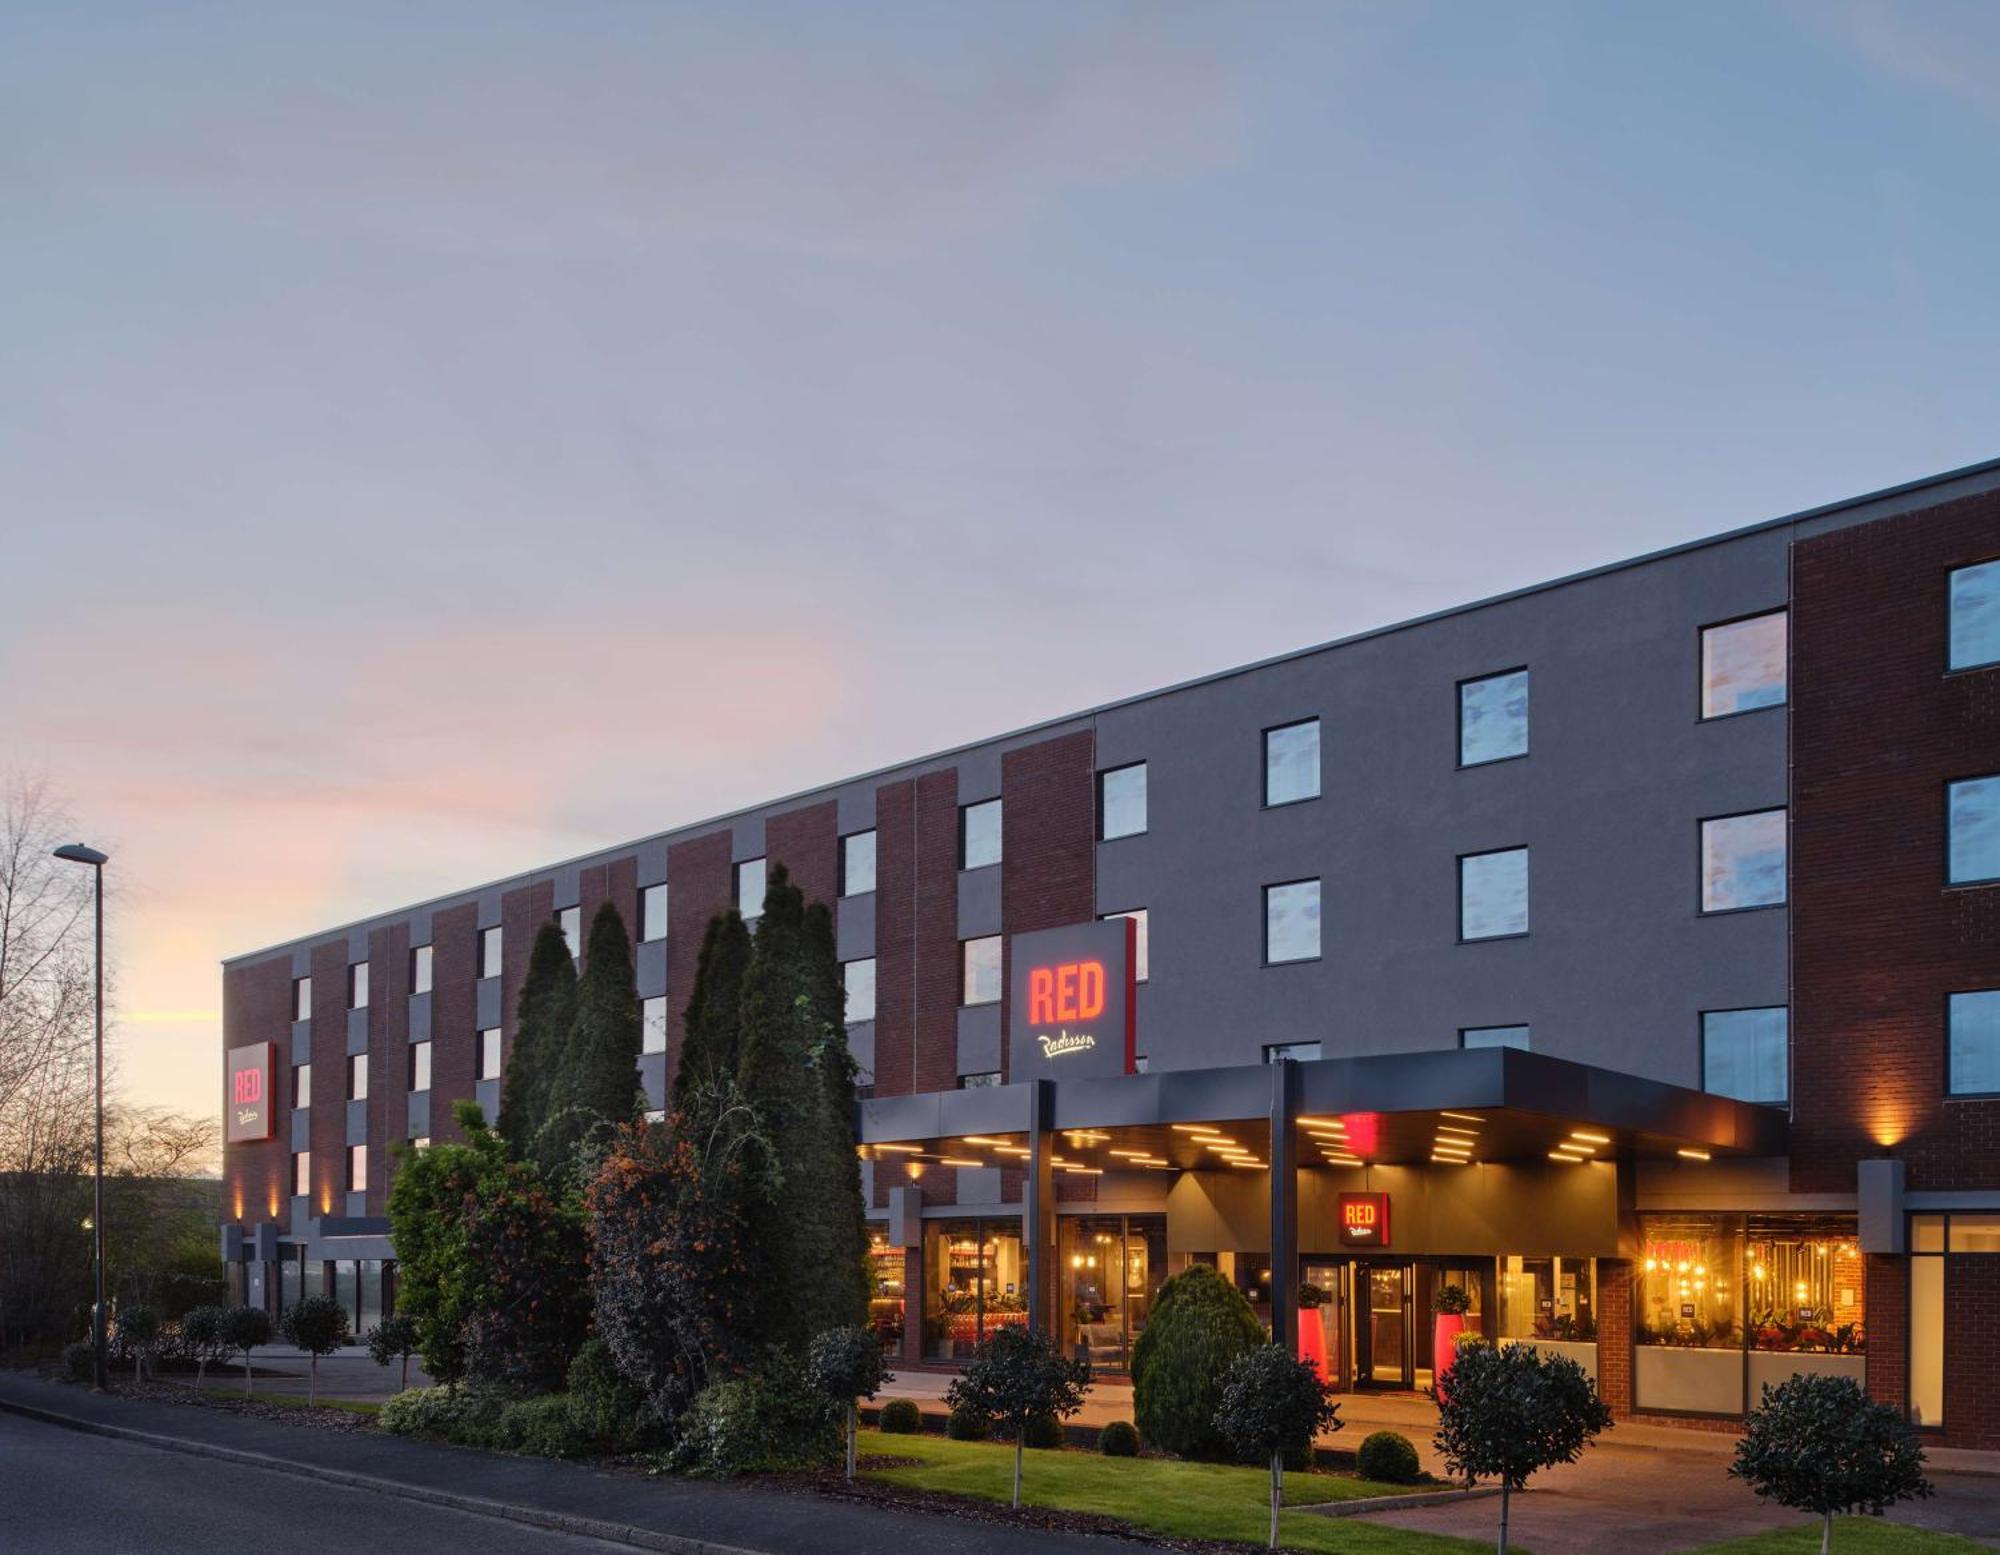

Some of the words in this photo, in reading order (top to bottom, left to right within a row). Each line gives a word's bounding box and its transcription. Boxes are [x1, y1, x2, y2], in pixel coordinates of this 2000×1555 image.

[1029, 961, 1105, 1025] RED
[235, 1067, 261, 1103] RED
[1346, 1204, 1374, 1225] RED
